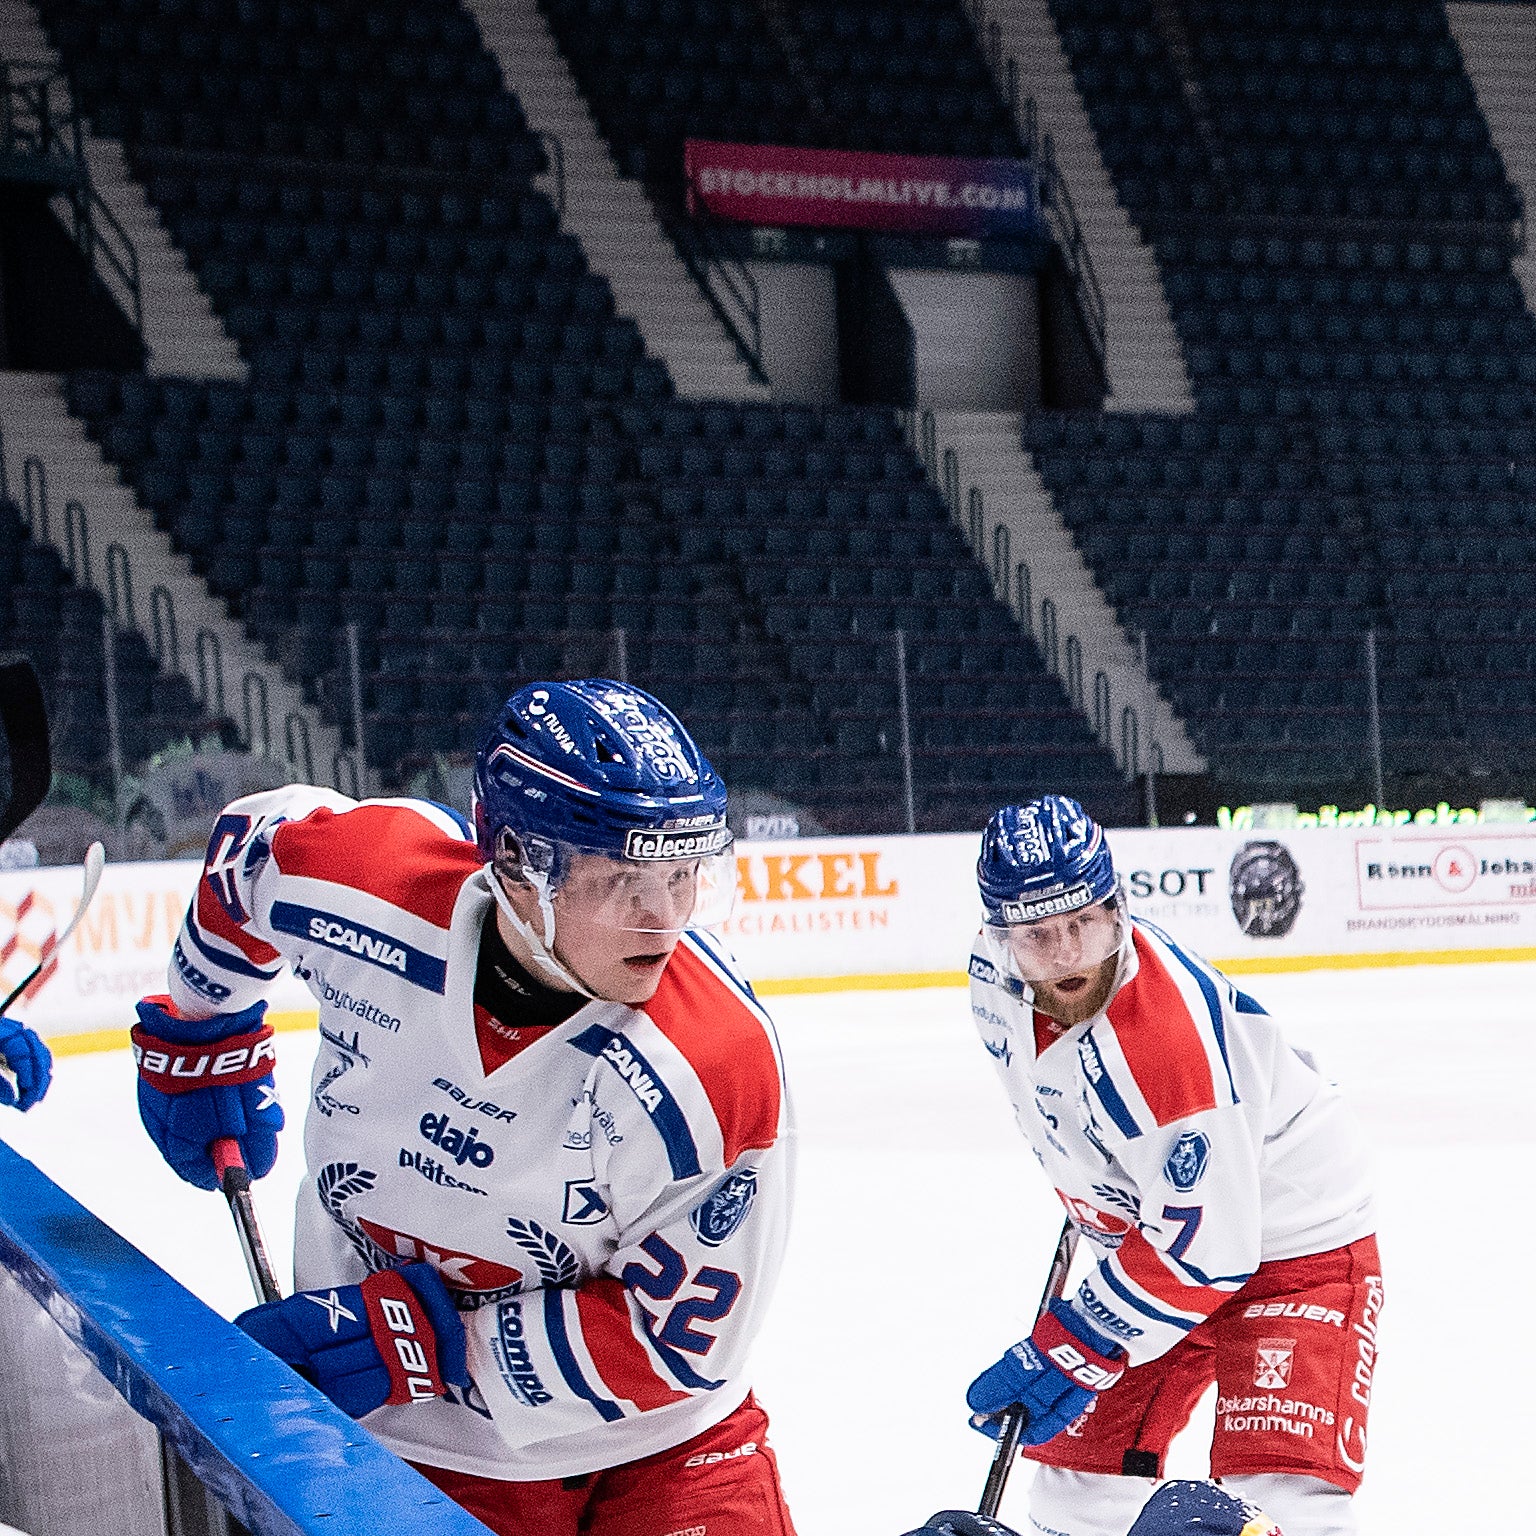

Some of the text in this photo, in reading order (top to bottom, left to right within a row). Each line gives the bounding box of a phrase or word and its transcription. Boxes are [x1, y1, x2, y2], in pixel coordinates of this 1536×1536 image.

[308, 916, 407, 972] SCANIA
[419, 1111, 495, 1169] elajo
[621, 1230, 743, 1357] 22
[1243, 1301, 1347, 1329] BAUER
[1216, 1392, 1336, 1428] Oskarshamns
[1224, 1411, 1315, 1440] kommun
